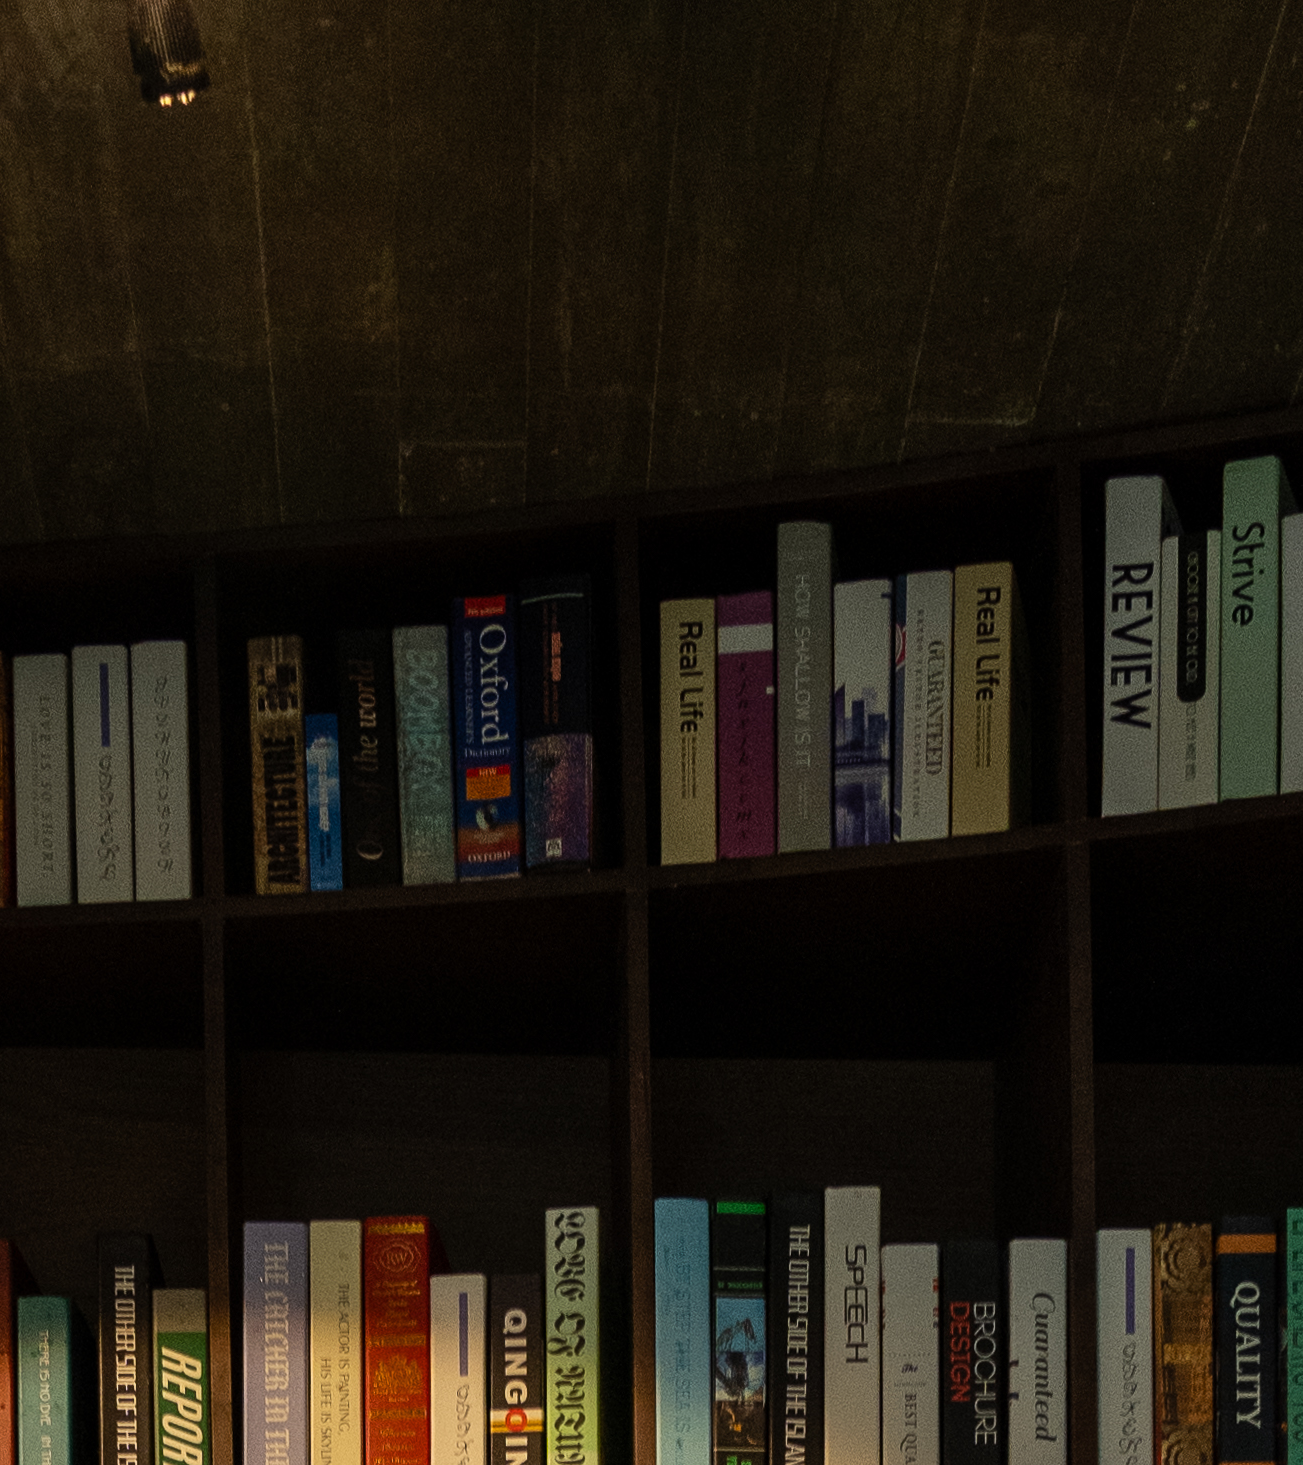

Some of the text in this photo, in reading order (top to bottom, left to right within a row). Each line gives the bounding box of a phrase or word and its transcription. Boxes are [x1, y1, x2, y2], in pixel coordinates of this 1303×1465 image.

[794, 573, 812, 620] HOW
[1232, 521, 1266, 627] Strive
[478, 622, 509, 745] Oxford
[679, 621, 704, 734] Real Life
[794, 625, 812, 720] SHALLOW
[976, 586, 1001, 701] Real Life
[1110, 561, 1155, 730] REVIEW
[925, 640, 946, 776] GUARANTEED
[784, 1224, 811, 1257] THE
[784, 1258, 811, 1314] OTHER
[337, 1283, 352, 1355] THE ACTOR
[949, 1301, 972, 1403] DESIGN
[1029, 1291, 1058, 1443] Guaranteed
[1229, 1279, 1261, 1430] QUALITY
[319, 1357, 334, 1408] HIS LIFE
[784, 1383, 811, 1415] THE
[904, 1392, 919, 1428] BEST
[973, 1301, 998, 1446] BROCHURE
